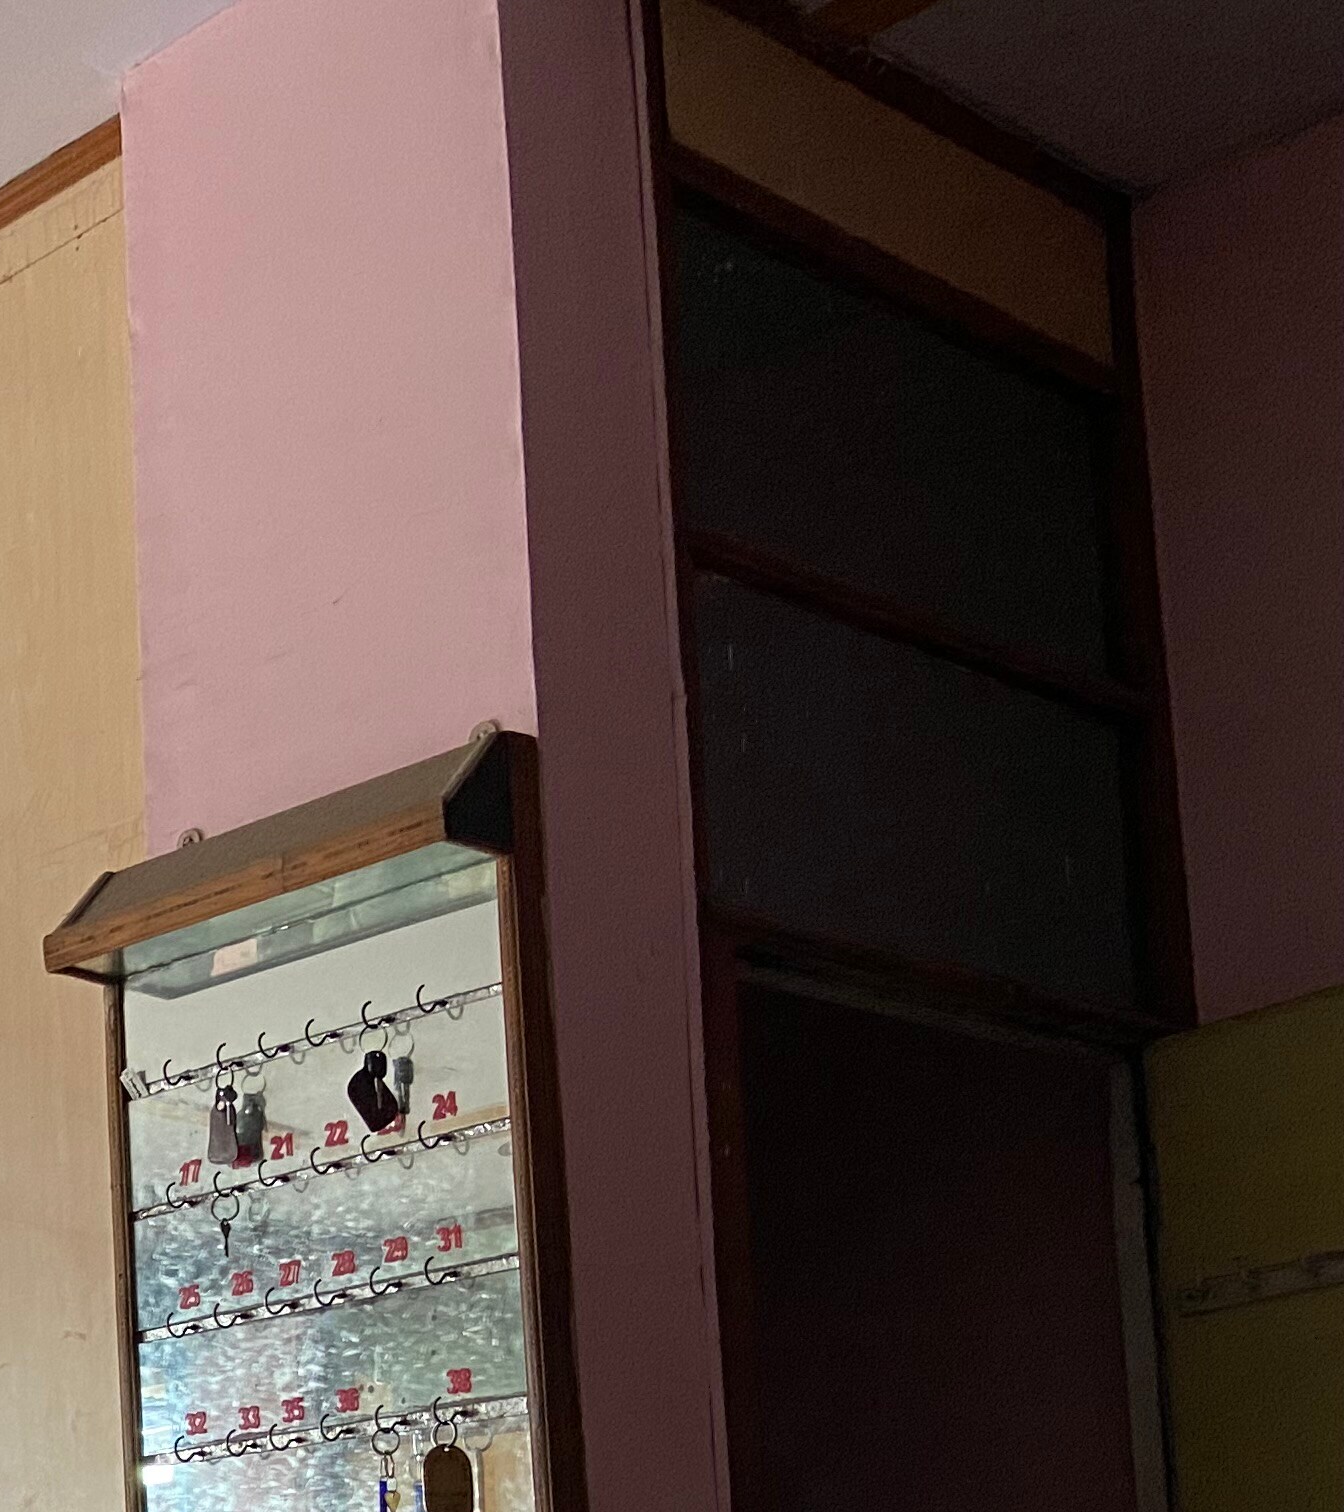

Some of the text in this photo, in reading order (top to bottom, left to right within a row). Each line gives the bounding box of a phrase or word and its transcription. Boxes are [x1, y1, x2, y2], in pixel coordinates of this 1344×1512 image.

[179, 1158, 202, 1187] 17
[270, 1133, 294, 1160] 21
[325, 1120, 349, 1147] 22
[432, 1091, 458, 1121] 24
[178, 1223, 463, 1310] 25 26 27 28 29 31
[185, 1411, 208, 1435] 32
[238, 1406, 261, 1430] 33
[281, 1396, 305, 1423] 35
